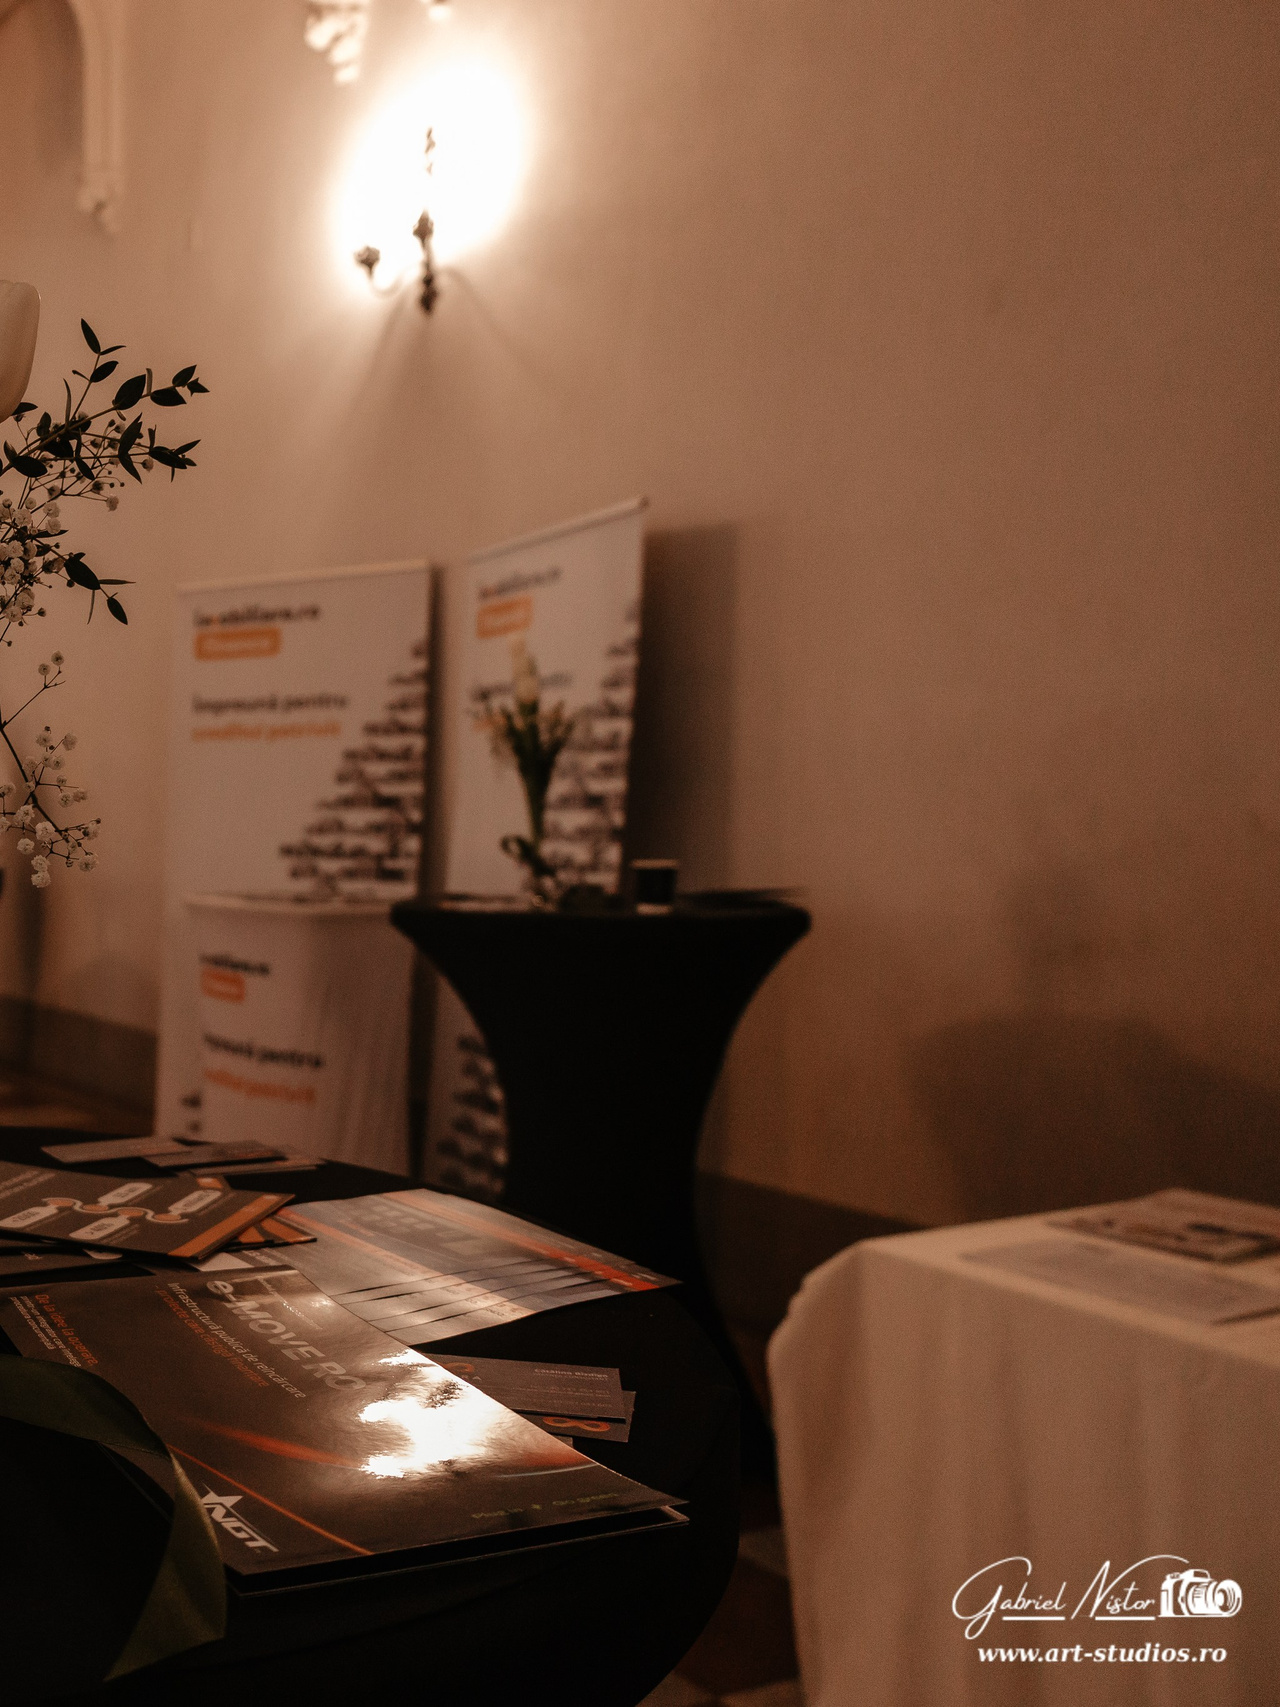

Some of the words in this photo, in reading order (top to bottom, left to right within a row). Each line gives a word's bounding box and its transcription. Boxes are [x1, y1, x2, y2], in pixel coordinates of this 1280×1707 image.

[35, 1294, 50, 1303] De
[167, 1282, 223, 1331] Infrastructură
[242, 1353, 259, 1363] de
[204, 1503, 280, 1553] NGT
